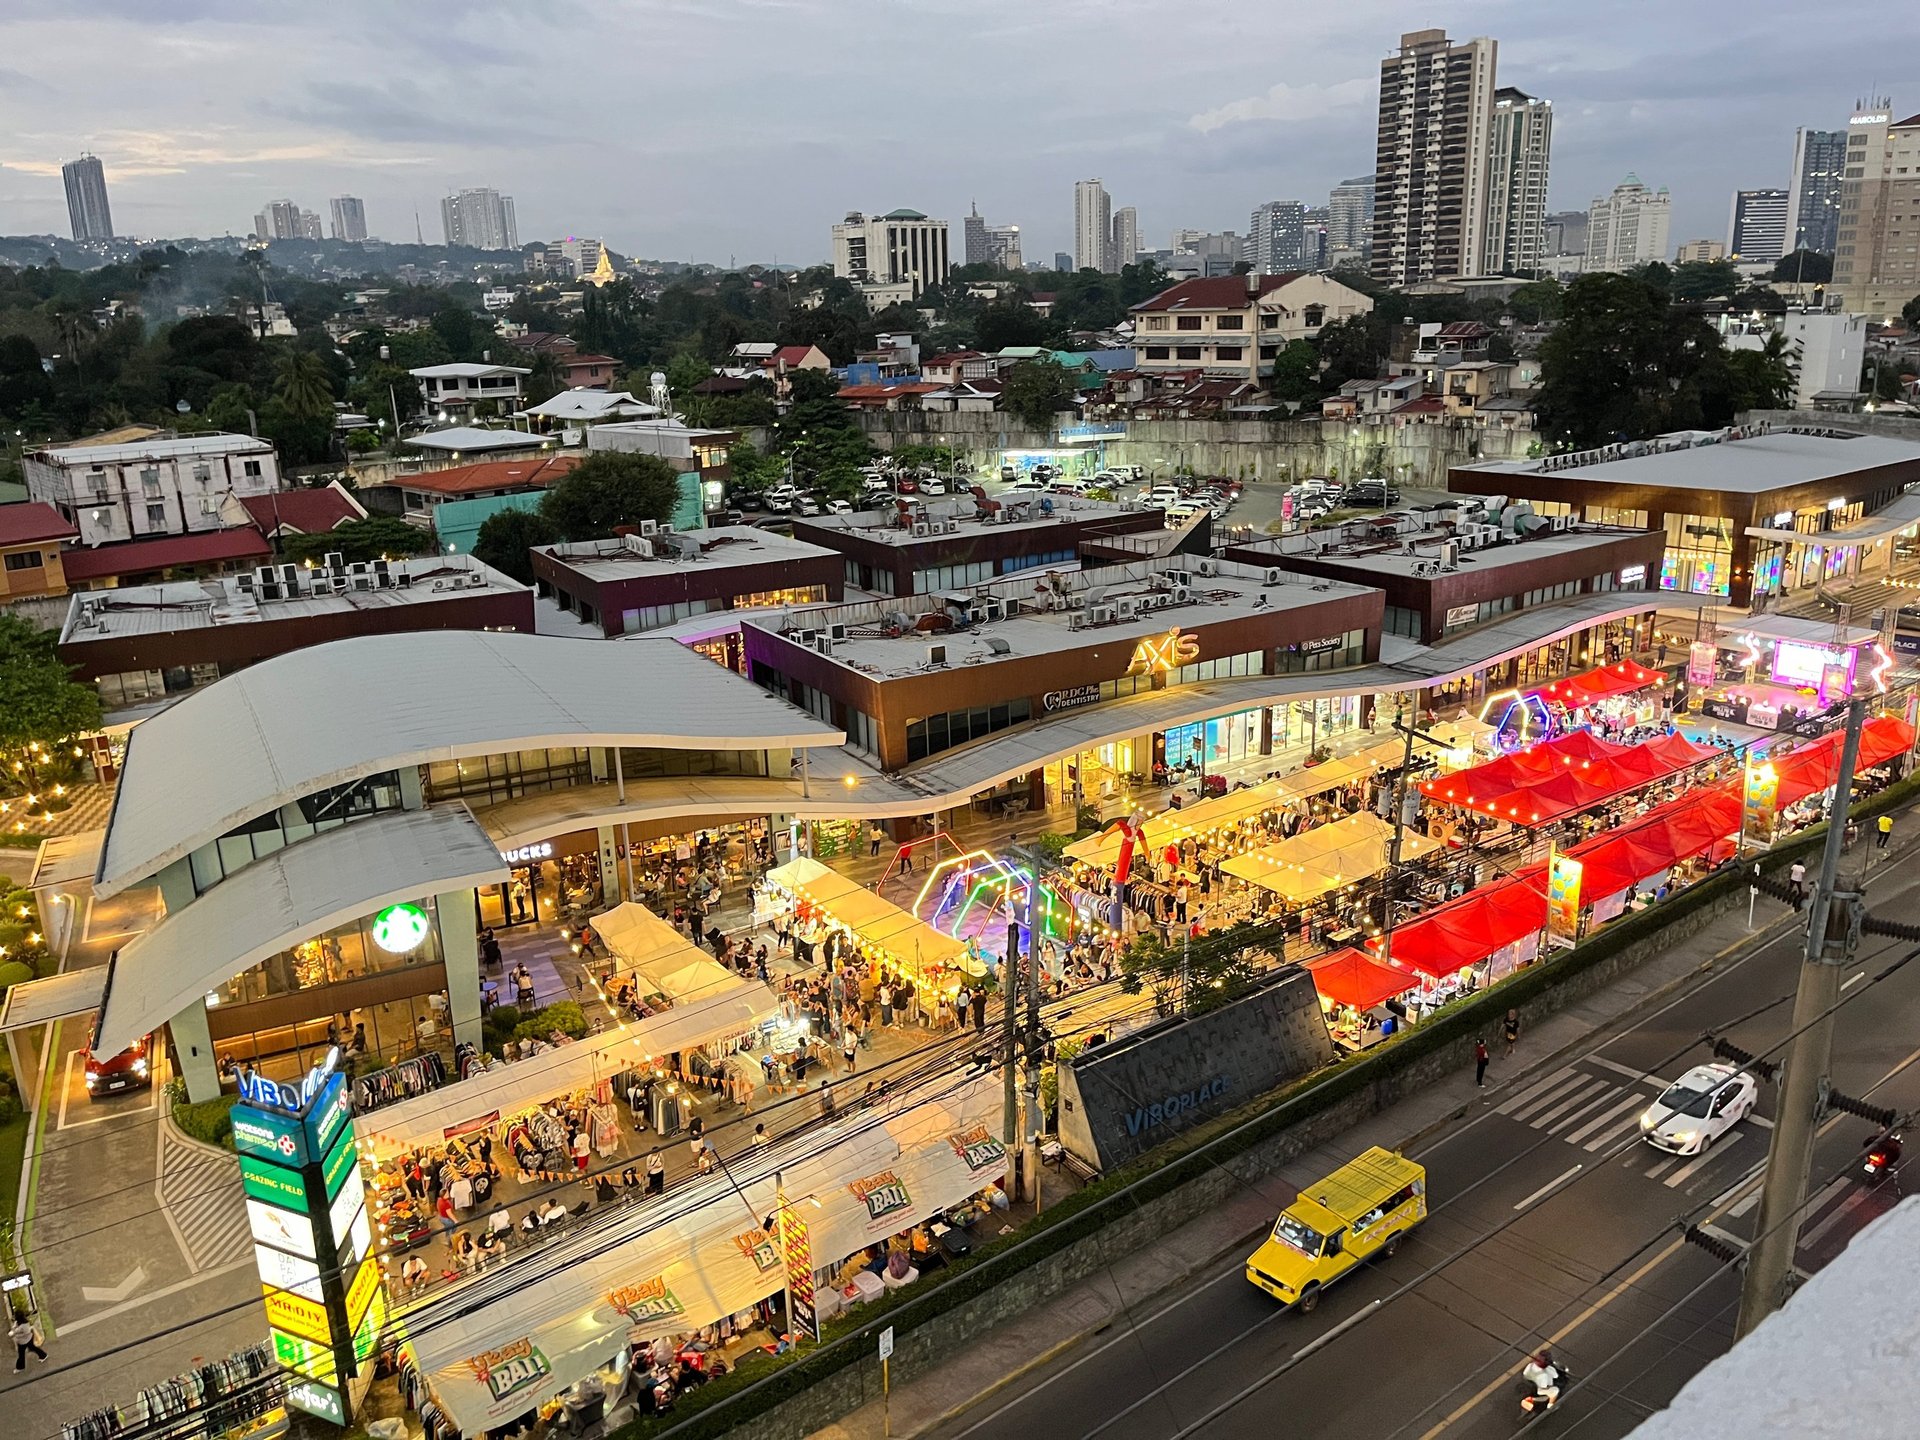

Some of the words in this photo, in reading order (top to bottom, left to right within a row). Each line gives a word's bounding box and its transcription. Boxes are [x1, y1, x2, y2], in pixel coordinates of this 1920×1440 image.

[1062, 687, 1084, 699] RDC
[1062, 694, 1099, 706] DENTISTRY
[968, 1142, 1004, 1166] BAI!
[243, 1171, 278, 1188] GRAZING
[280, 1183, 303, 1196] FIELD
[870, 1186, 907, 1213] BAI!
[632, 1298, 679, 1321] BAI!
[493, 1355, 546, 1395] BAI!
